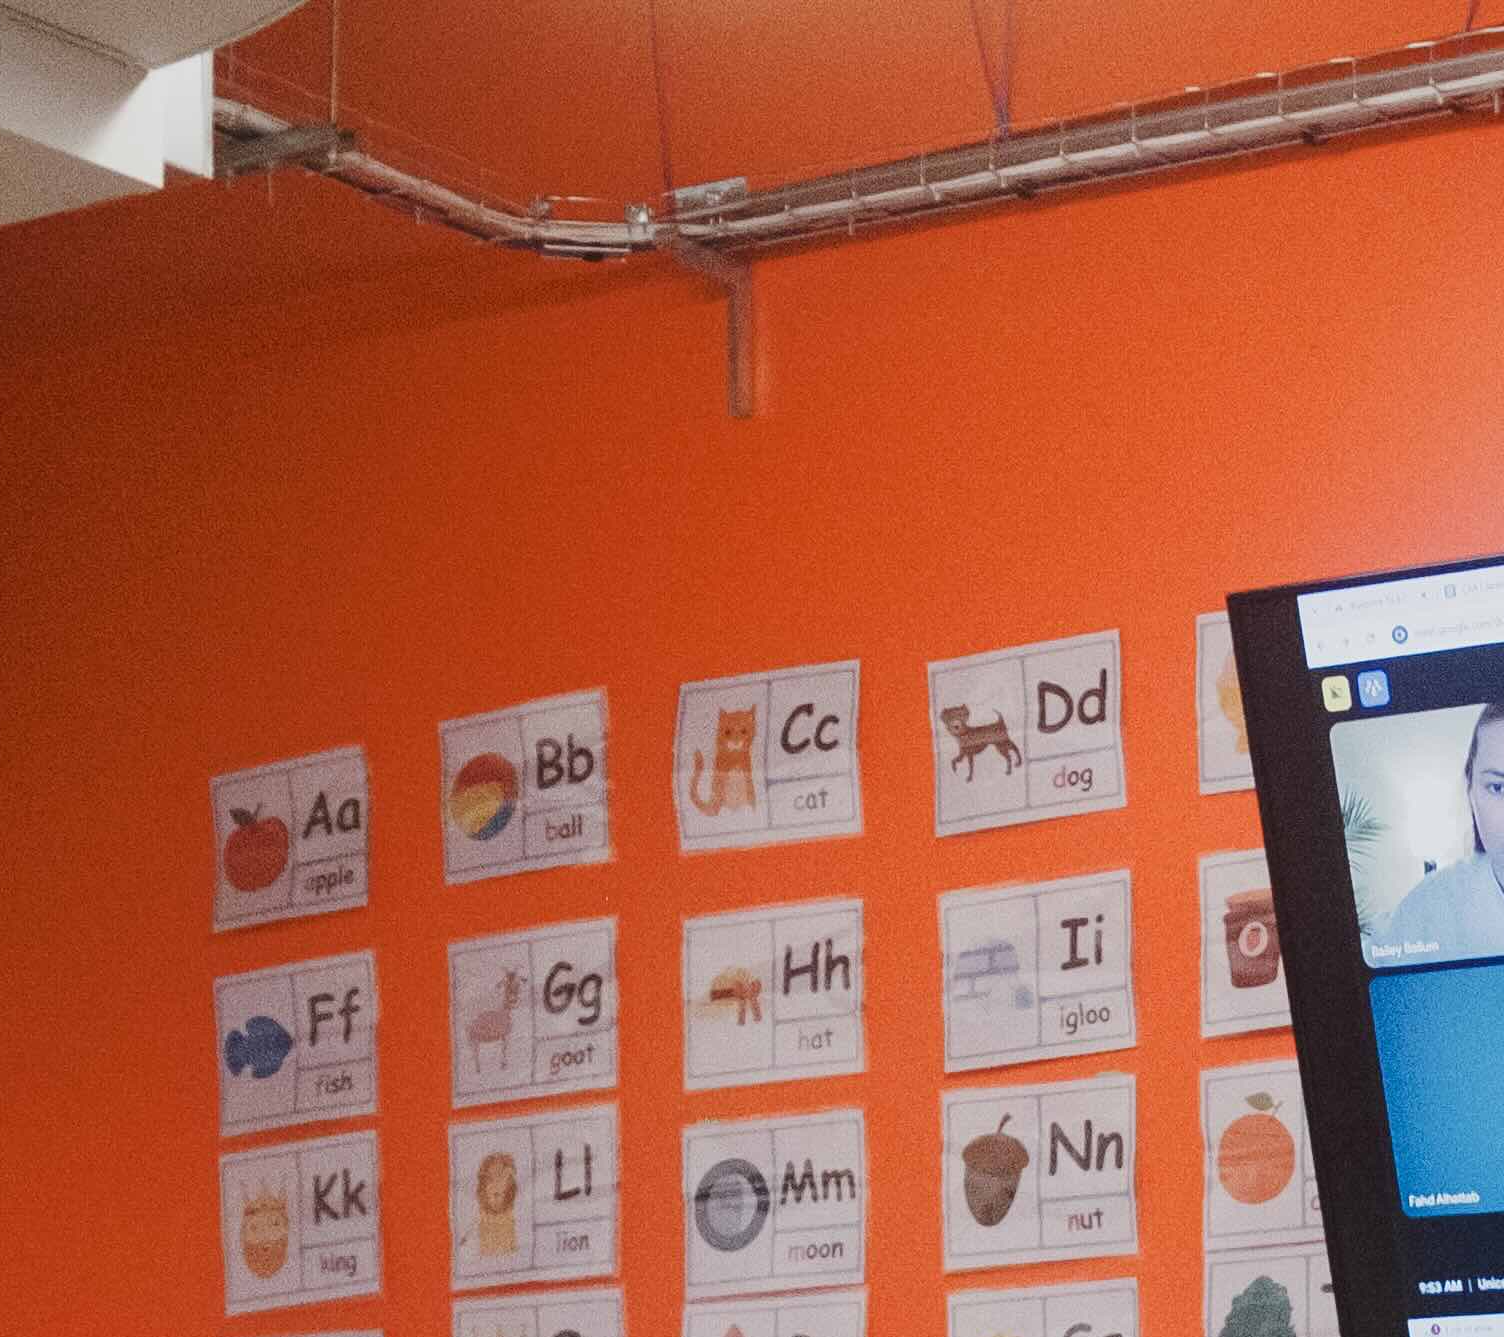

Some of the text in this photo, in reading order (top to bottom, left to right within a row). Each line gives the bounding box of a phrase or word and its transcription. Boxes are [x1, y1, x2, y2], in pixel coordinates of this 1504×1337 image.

[1037, 668, 1108, 734] Dd
[779, 703, 841, 756] Cc
[536, 733, 594, 790] Bb
[1053, 765, 1093, 793] dog
[302, 789, 361, 840] Aa
[793, 788, 829, 813] cat
[543, 811, 583, 841] ball
[303, 865, 356, 896] apple
[1060, 914, 1105, 972] Ii
[782, 936, 851, 996] Hh
[542, 960, 603, 1027] Gg
[307, 987, 361, 1047] Ff
[1060, 1003, 1110, 1036] igloo
[797, 1027, 834, 1053] hat
[550, 1046, 597, 1074] goat
[313, 1071, 353, 1097] fish
[1048, 1119, 1124, 1176] Nn
[554, 1144, 592, 1202] Ll
[779, 1158, 857, 1205] Mm
[313, 1169, 368, 1225] Kk
[1067, 1208, 1104, 1232] nut
[554, 1231, 590, 1256] lion
[788, 1238, 845, 1261] moon
[320, 1251, 358, 1278] king
[1444, 1279, 1463, 1294] AM
